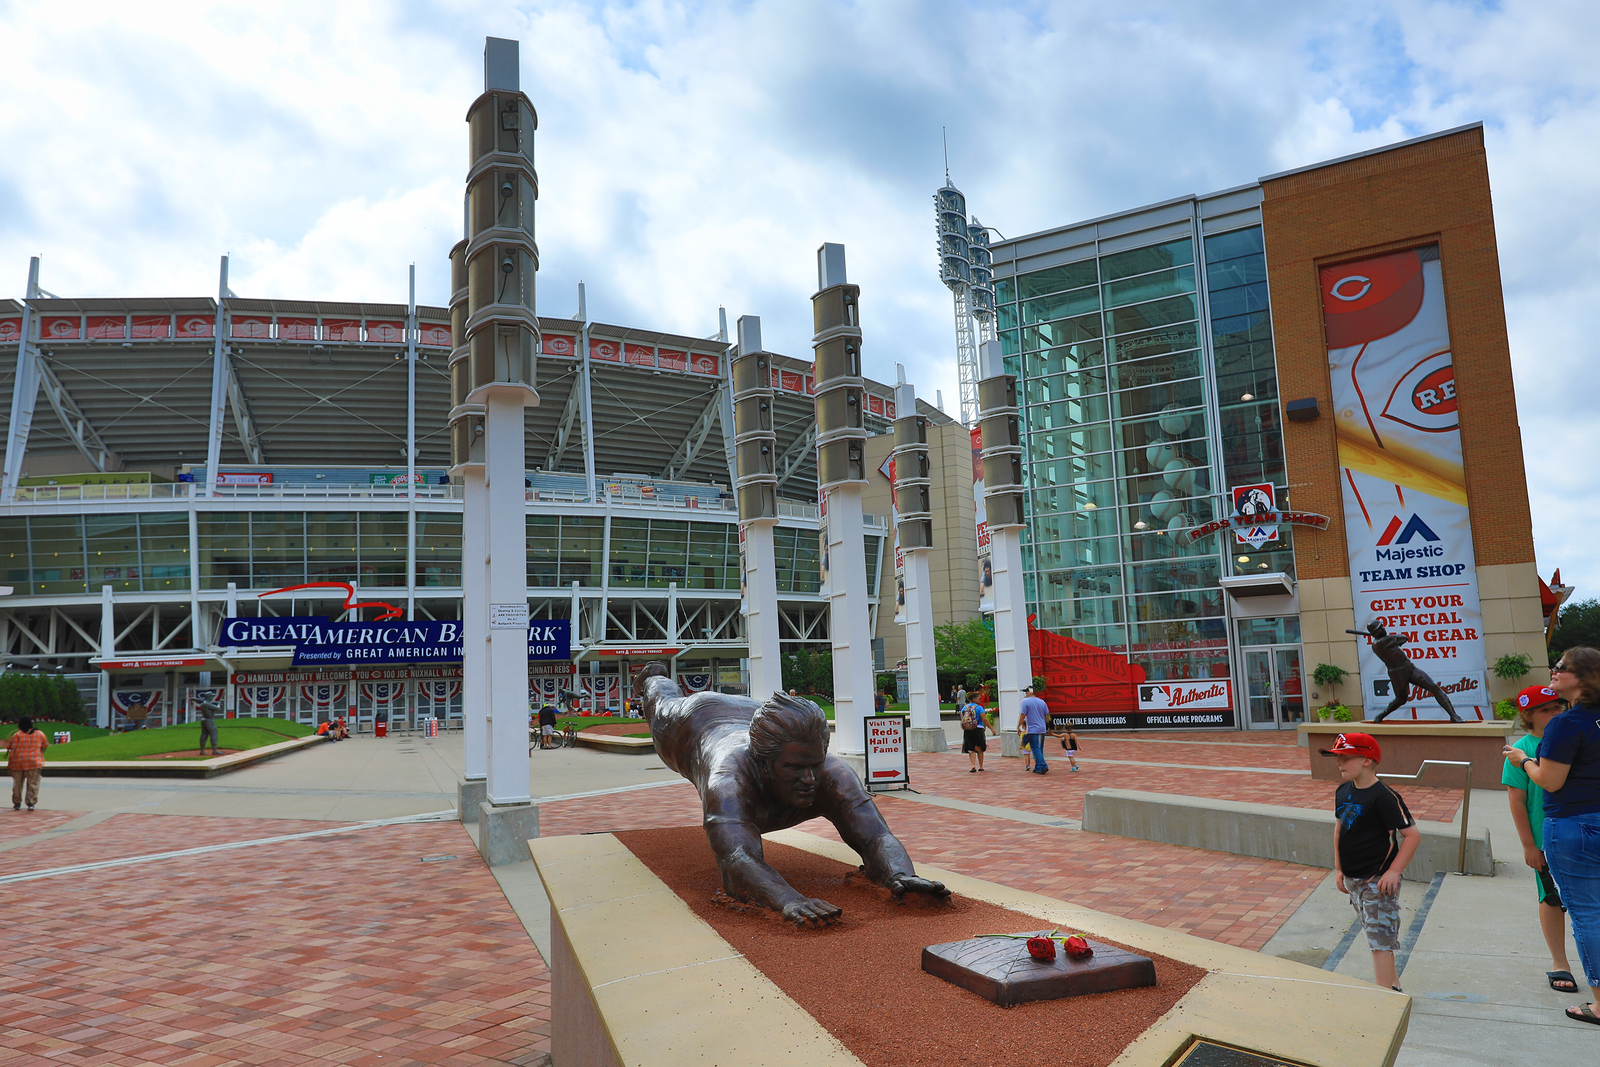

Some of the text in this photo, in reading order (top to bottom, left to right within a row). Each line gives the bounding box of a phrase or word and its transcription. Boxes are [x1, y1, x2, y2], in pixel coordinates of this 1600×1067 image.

[1416, 379, 1456, 409] RE
[1191, 519, 1231, 540] REDS
[1234, 513, 1276, 526] TEAM
[1282, 513, 1326, 526] SHOP
[978, 533, 991, 548] ROS
[1376, 546, 1444, 563] Majestic
[1359, 563, 1466, 583] TEAM SHOP
[1370, 594, 1464, 612] GET YOUR
[1375, 612, 1463, 628] OFFICIAL
[227, 620, 313, 642] GREAT
[303, 624, 430, 646] AMERICAN
[1363, 628, 1479, 646] TM GEAR
[298, 651, 331, 660] Presented
[333, 651, 342, 660] by
[346, 648, 383, 659] GREAT
[388, 647, 448, 658] AMERICAN
[528, 645, 557, 655] ROUP
[1042, 630, 1126, 678] RED STOCKINGS
[1404, 646, 1457, 660] ODAY!
[247, 673, 284, 683] HAMILTON
[286, 672, 313, 682] COUNTY
[315, 671, 353, 681] WELCOMES
[356, 671, 369, 680] YOU
[383, 670, 396, 679] 100
[397, 669, 408, 678] JOE
[410, 668, 440, 678] NUXHALL
[442, 668, 456, 677] WAY
[554, 665, 570, 674] REDS
[1051, 673, 1088, 684] 1869
[1168, 684, 1225, 707] Authentic
[1053, 716, 1127, 726] COLLECTIBLE BOBBLEHEADS
[1146, 715, 1223, 724] OFFICIAL GAME PROGRAMS
[872, 728, 899, 736] Reds
[869, 737, 888, 745] Hall
[873, 746, 899, 754] Fame
